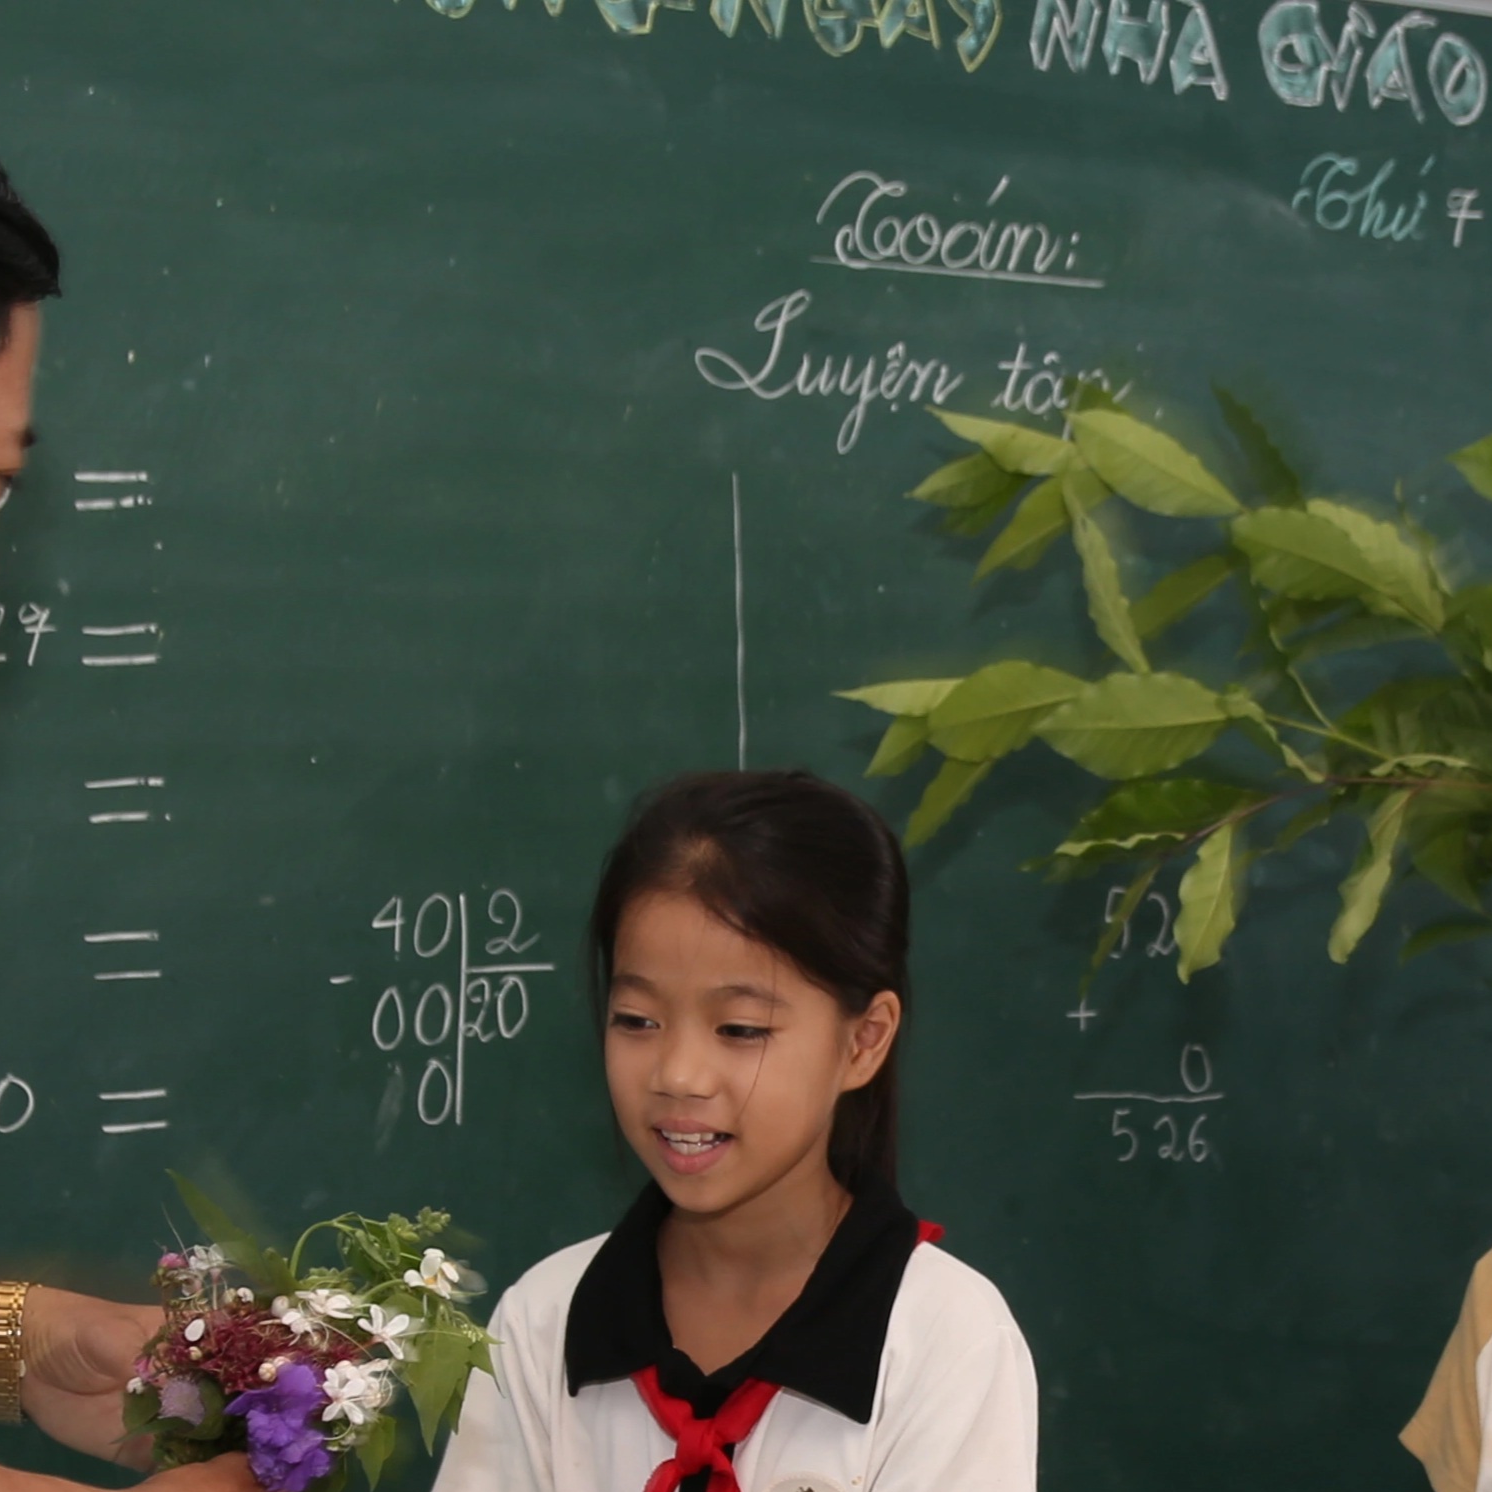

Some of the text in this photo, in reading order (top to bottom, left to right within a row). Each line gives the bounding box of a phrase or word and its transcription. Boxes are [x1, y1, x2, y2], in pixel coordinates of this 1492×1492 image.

[1446, 187, 1485, 248] 7
[694, 289, 966, 455] Luyện
[371, 887, 541, 958] 40 2
[1111, 1108, 1211, 1163] 526
